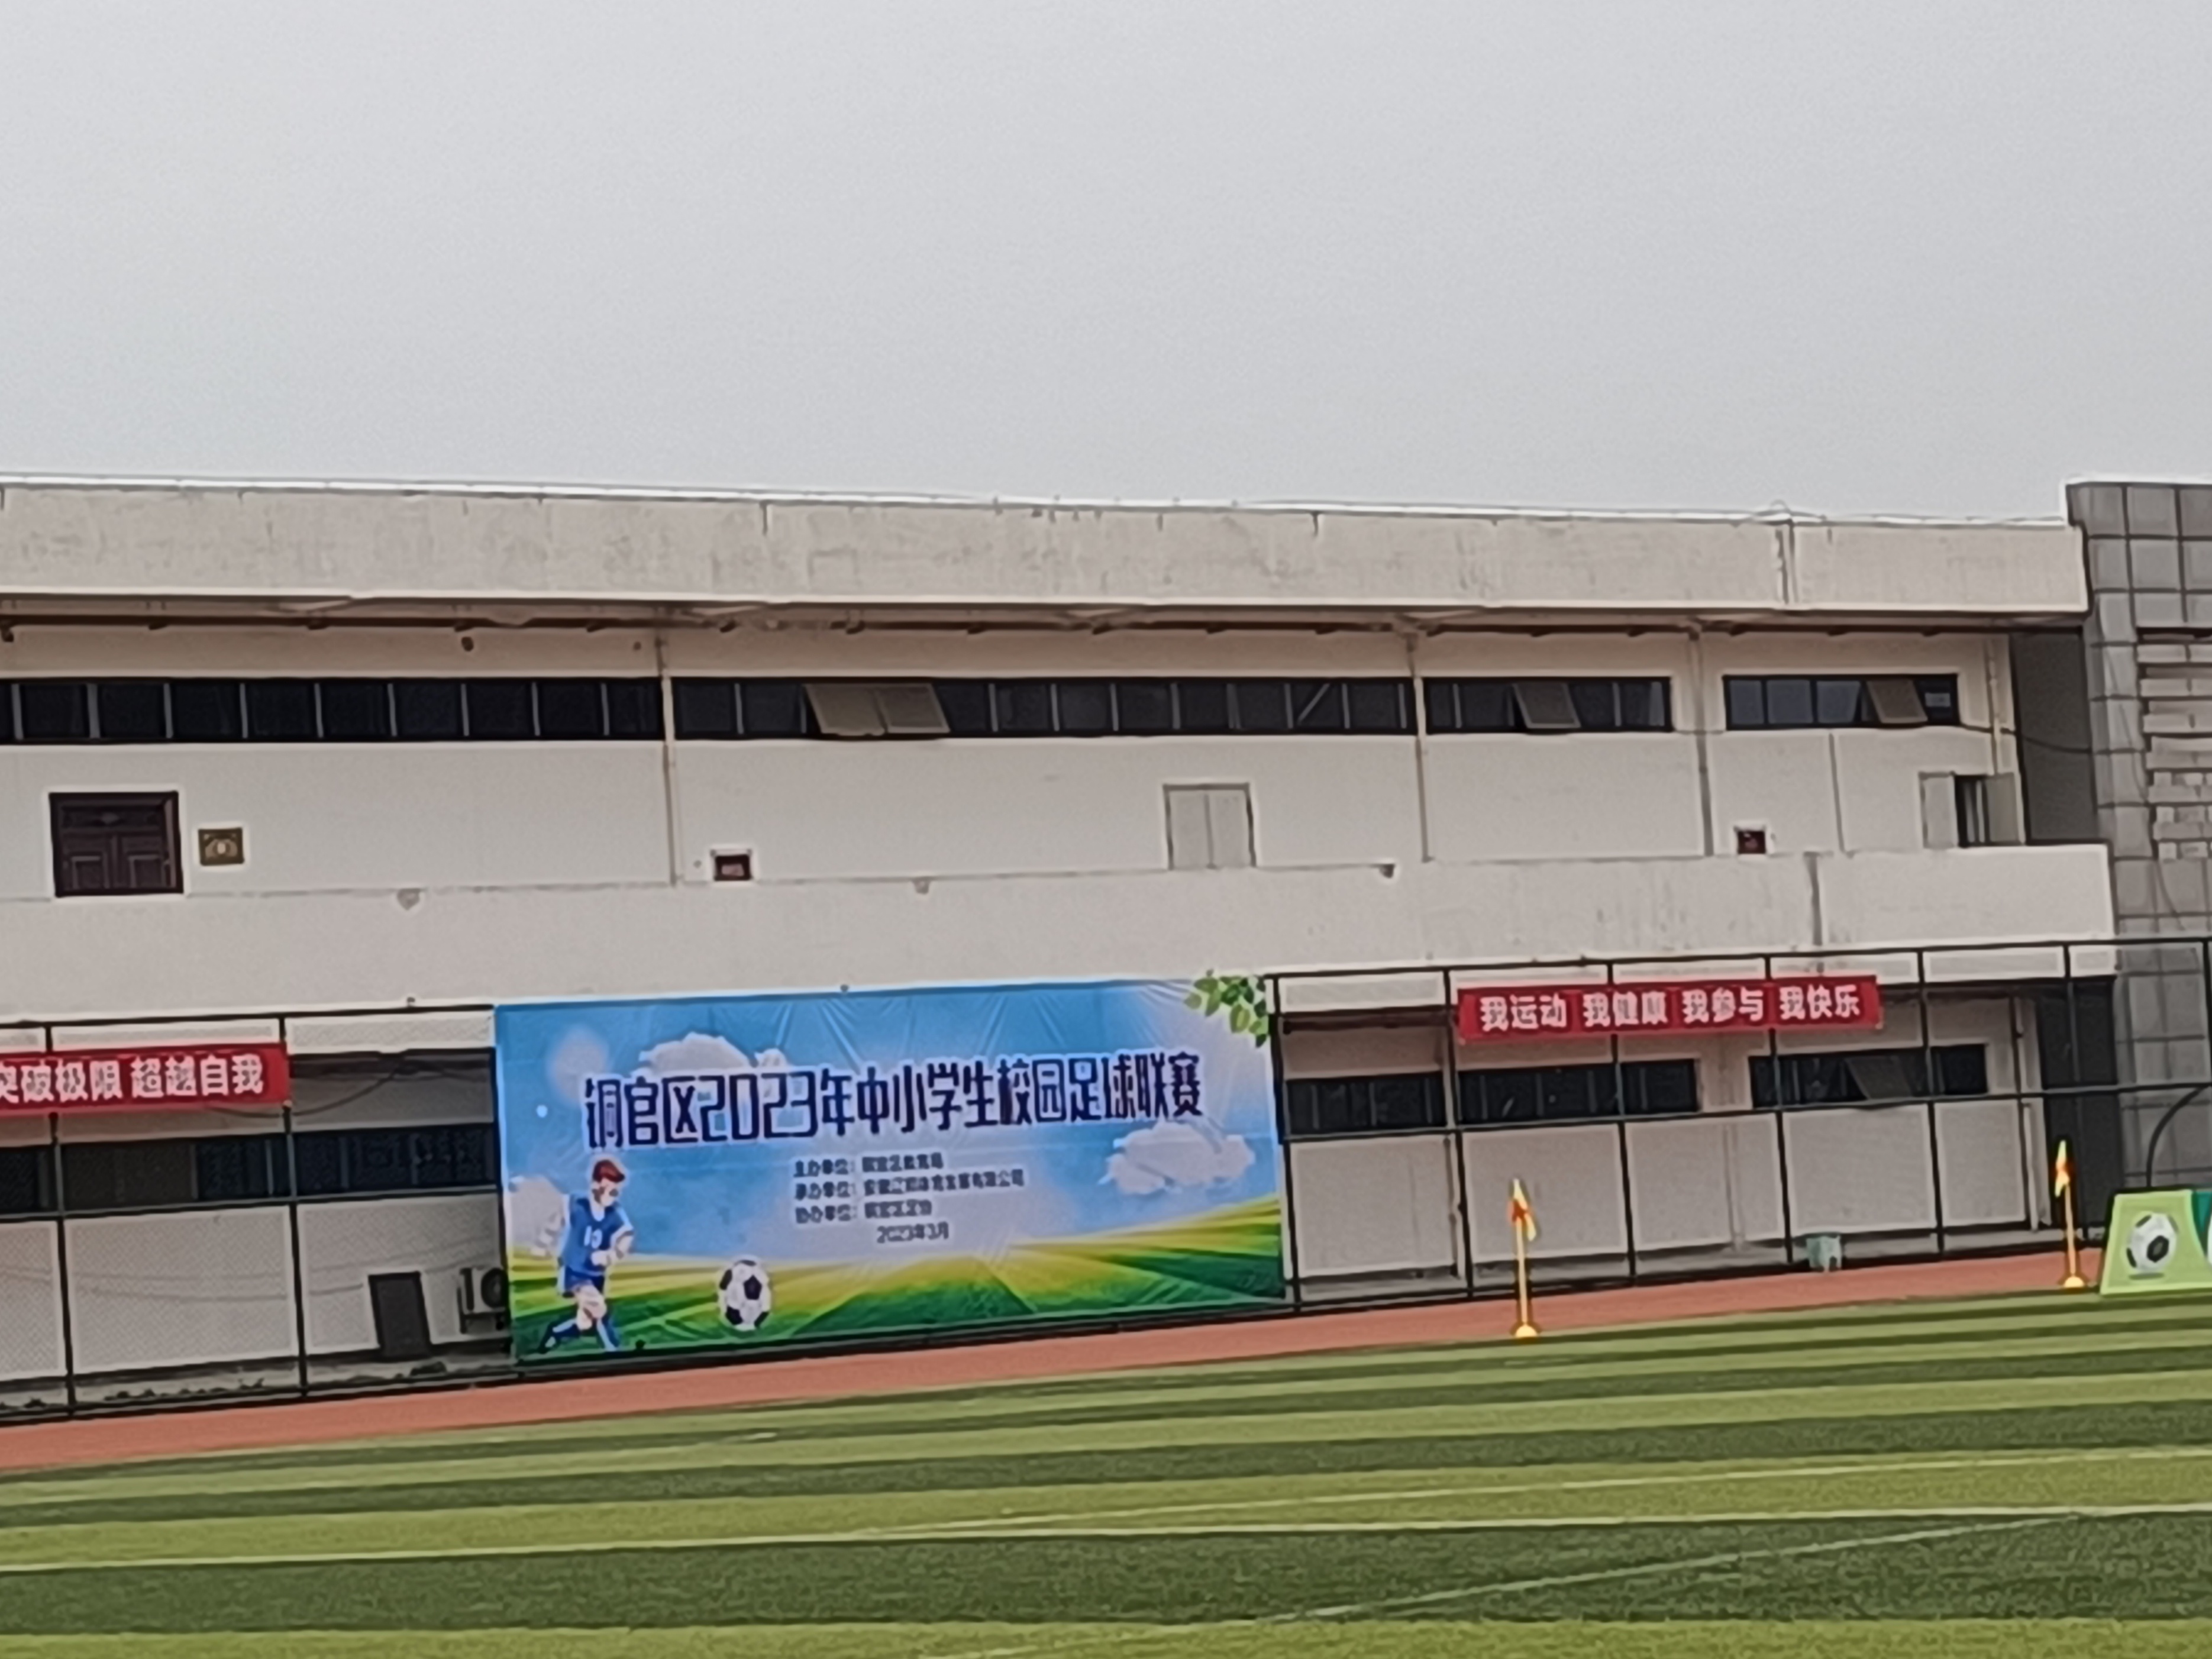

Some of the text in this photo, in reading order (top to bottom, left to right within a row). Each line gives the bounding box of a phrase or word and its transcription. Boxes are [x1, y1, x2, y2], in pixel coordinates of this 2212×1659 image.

[1480, 992, 1567, 1032] 我运动
[1682, 986, 1764, 1024] 我参与
[1780, 983, 1861, 1021] 我快乐
[130, 1053, 264, 1098] 超越自我
[585, 1051, 1203, 1149] 铜官区2023年中小学生校园足球联赛
